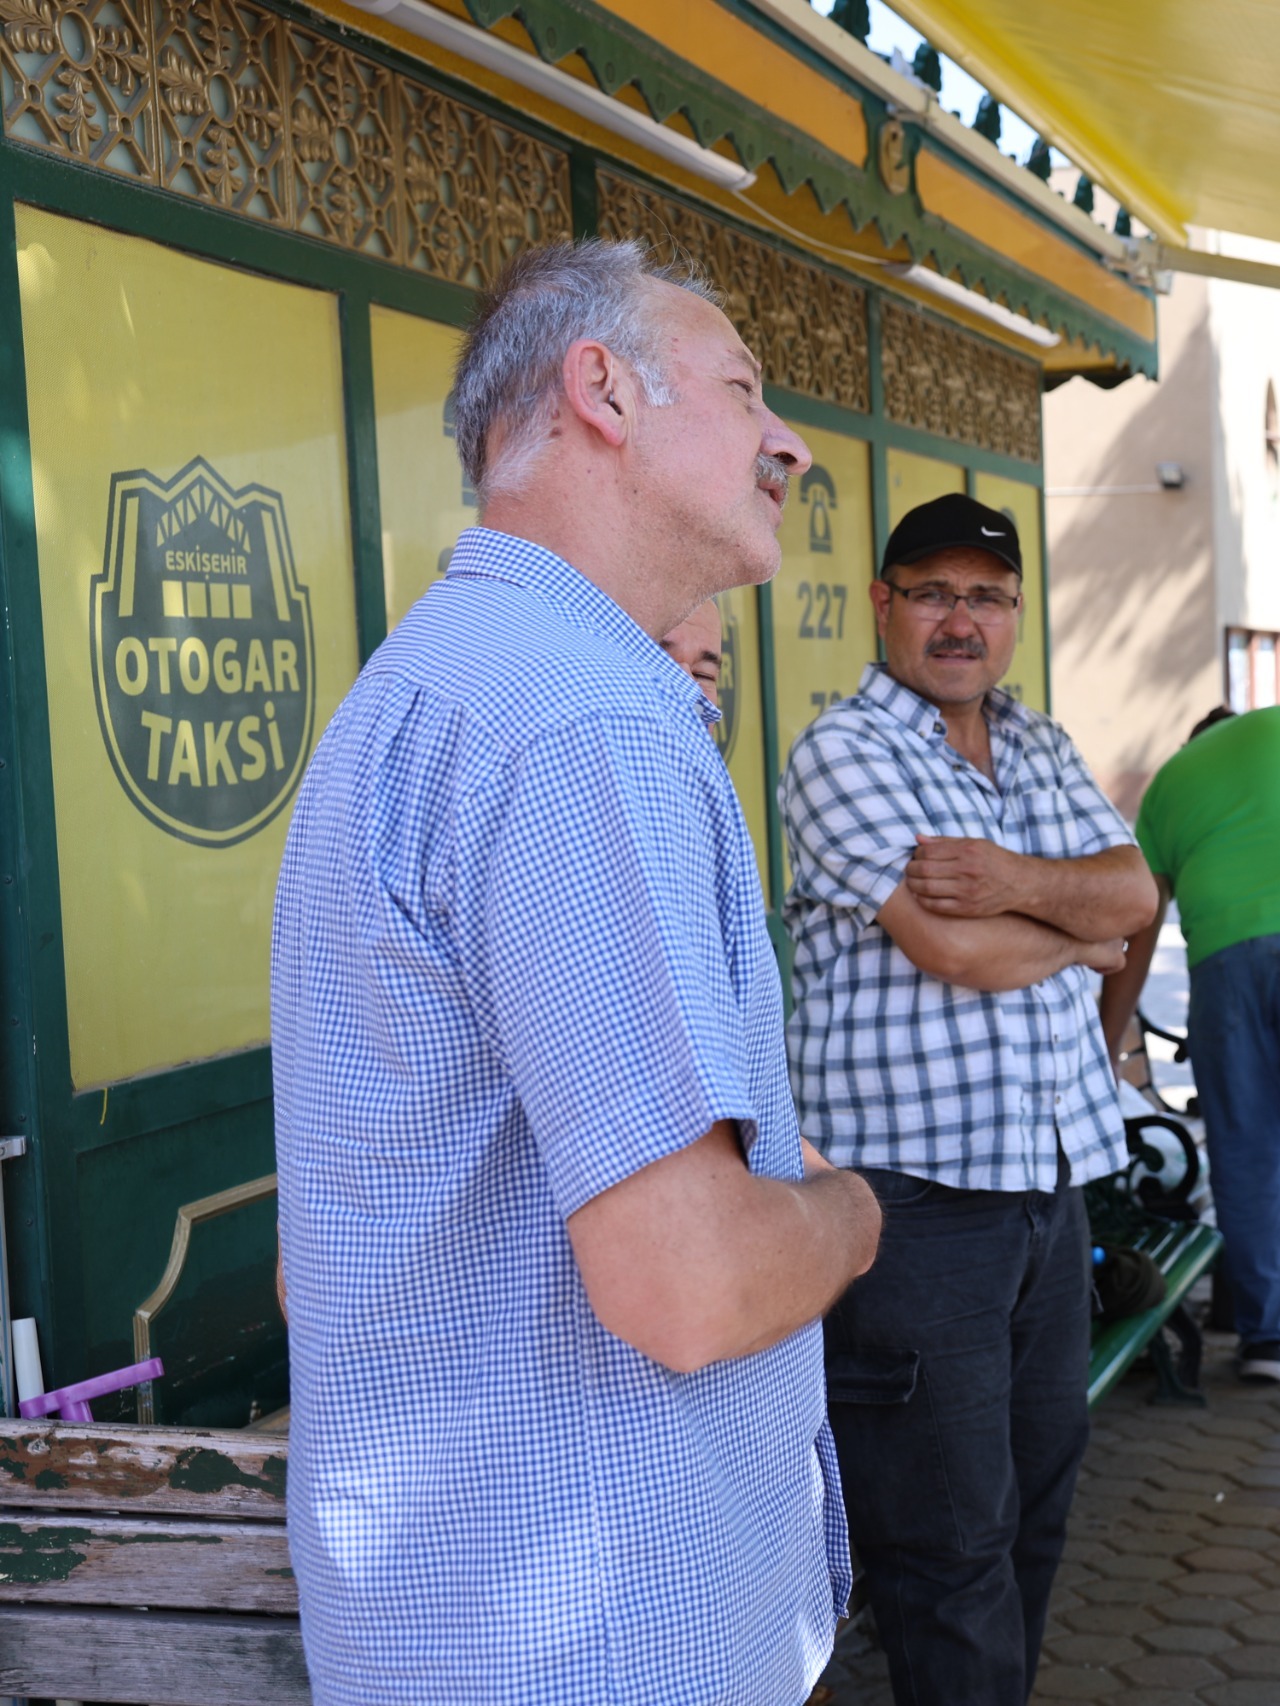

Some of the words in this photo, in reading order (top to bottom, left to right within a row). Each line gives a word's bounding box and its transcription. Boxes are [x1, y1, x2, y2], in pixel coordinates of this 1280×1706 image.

[165, 544, 247, 579] ESKİŞEHİR
[797, 580, 848, 640] 227
[115, 637, 300, 696] OTOGAR
